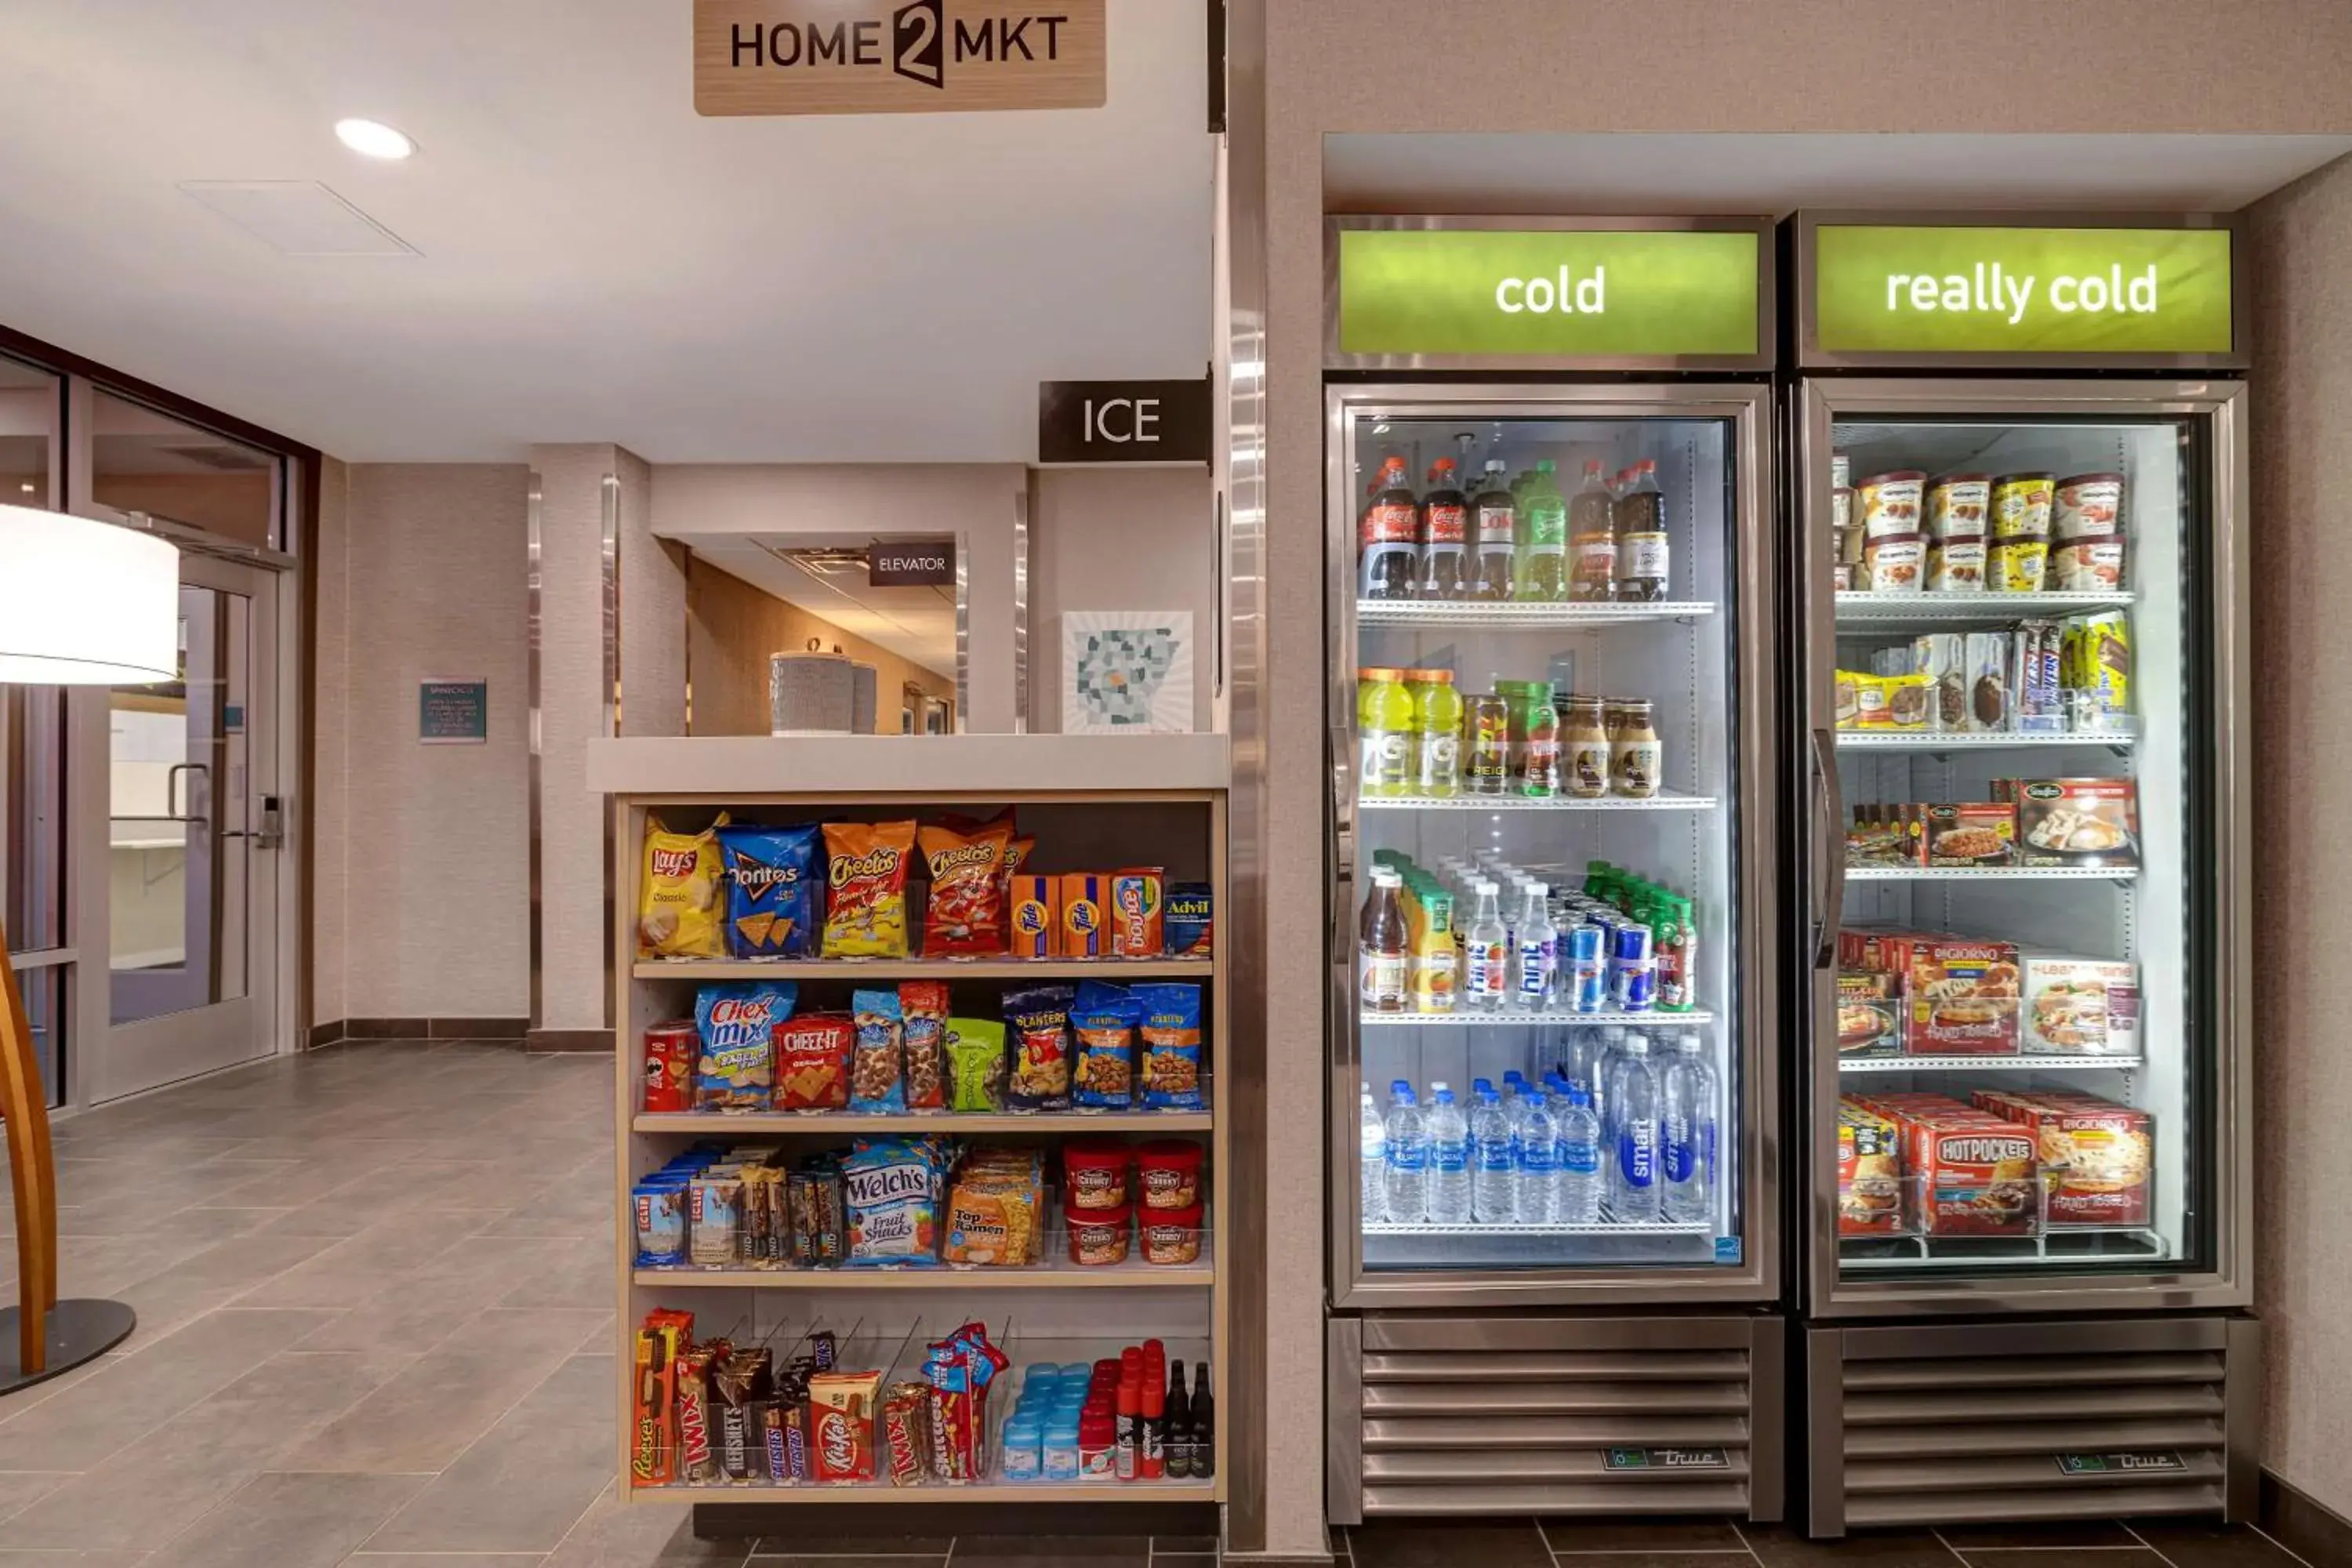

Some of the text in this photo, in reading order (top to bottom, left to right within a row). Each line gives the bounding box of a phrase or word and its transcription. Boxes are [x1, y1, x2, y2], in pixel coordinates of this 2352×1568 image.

[731, 5, 1069, 80] HOME 2 MKT
[1495, 263, 1606, 314] cold
[1886, 261, 2158, 325] really cold
[1083, 398, 1160, 442] ICE
[878, 557, 946, 572] ELEVATOR
[654, 849, 695, 877] Lay's
[831, 850, 898, 888] Cheetos
[1022, 903, 1042, 931] Tide
[1073, 902, 1094, 931] Tide
[1167, 900, 1209, 913] Advil
[1519, 944, 1540, 993] hint
[711, 992, 775, 1025] Chex
[1633, 1119, 1650, 1178] smart
[1943, 1139, 2031, 1161] HOT POCKETS
[848, 1167, 924, 1201] Welch's
[865, 1223, 913, 1243] Snacks
[873, 1212, 906, 1229] Fruit
[955, 1209, 982, 1224] Top
[955, 1220, 1004, 1235] Ramen
[680, 1392, 710, 1465] TWIX
[724, 1407, 745, 1472] HERSHEY'S
